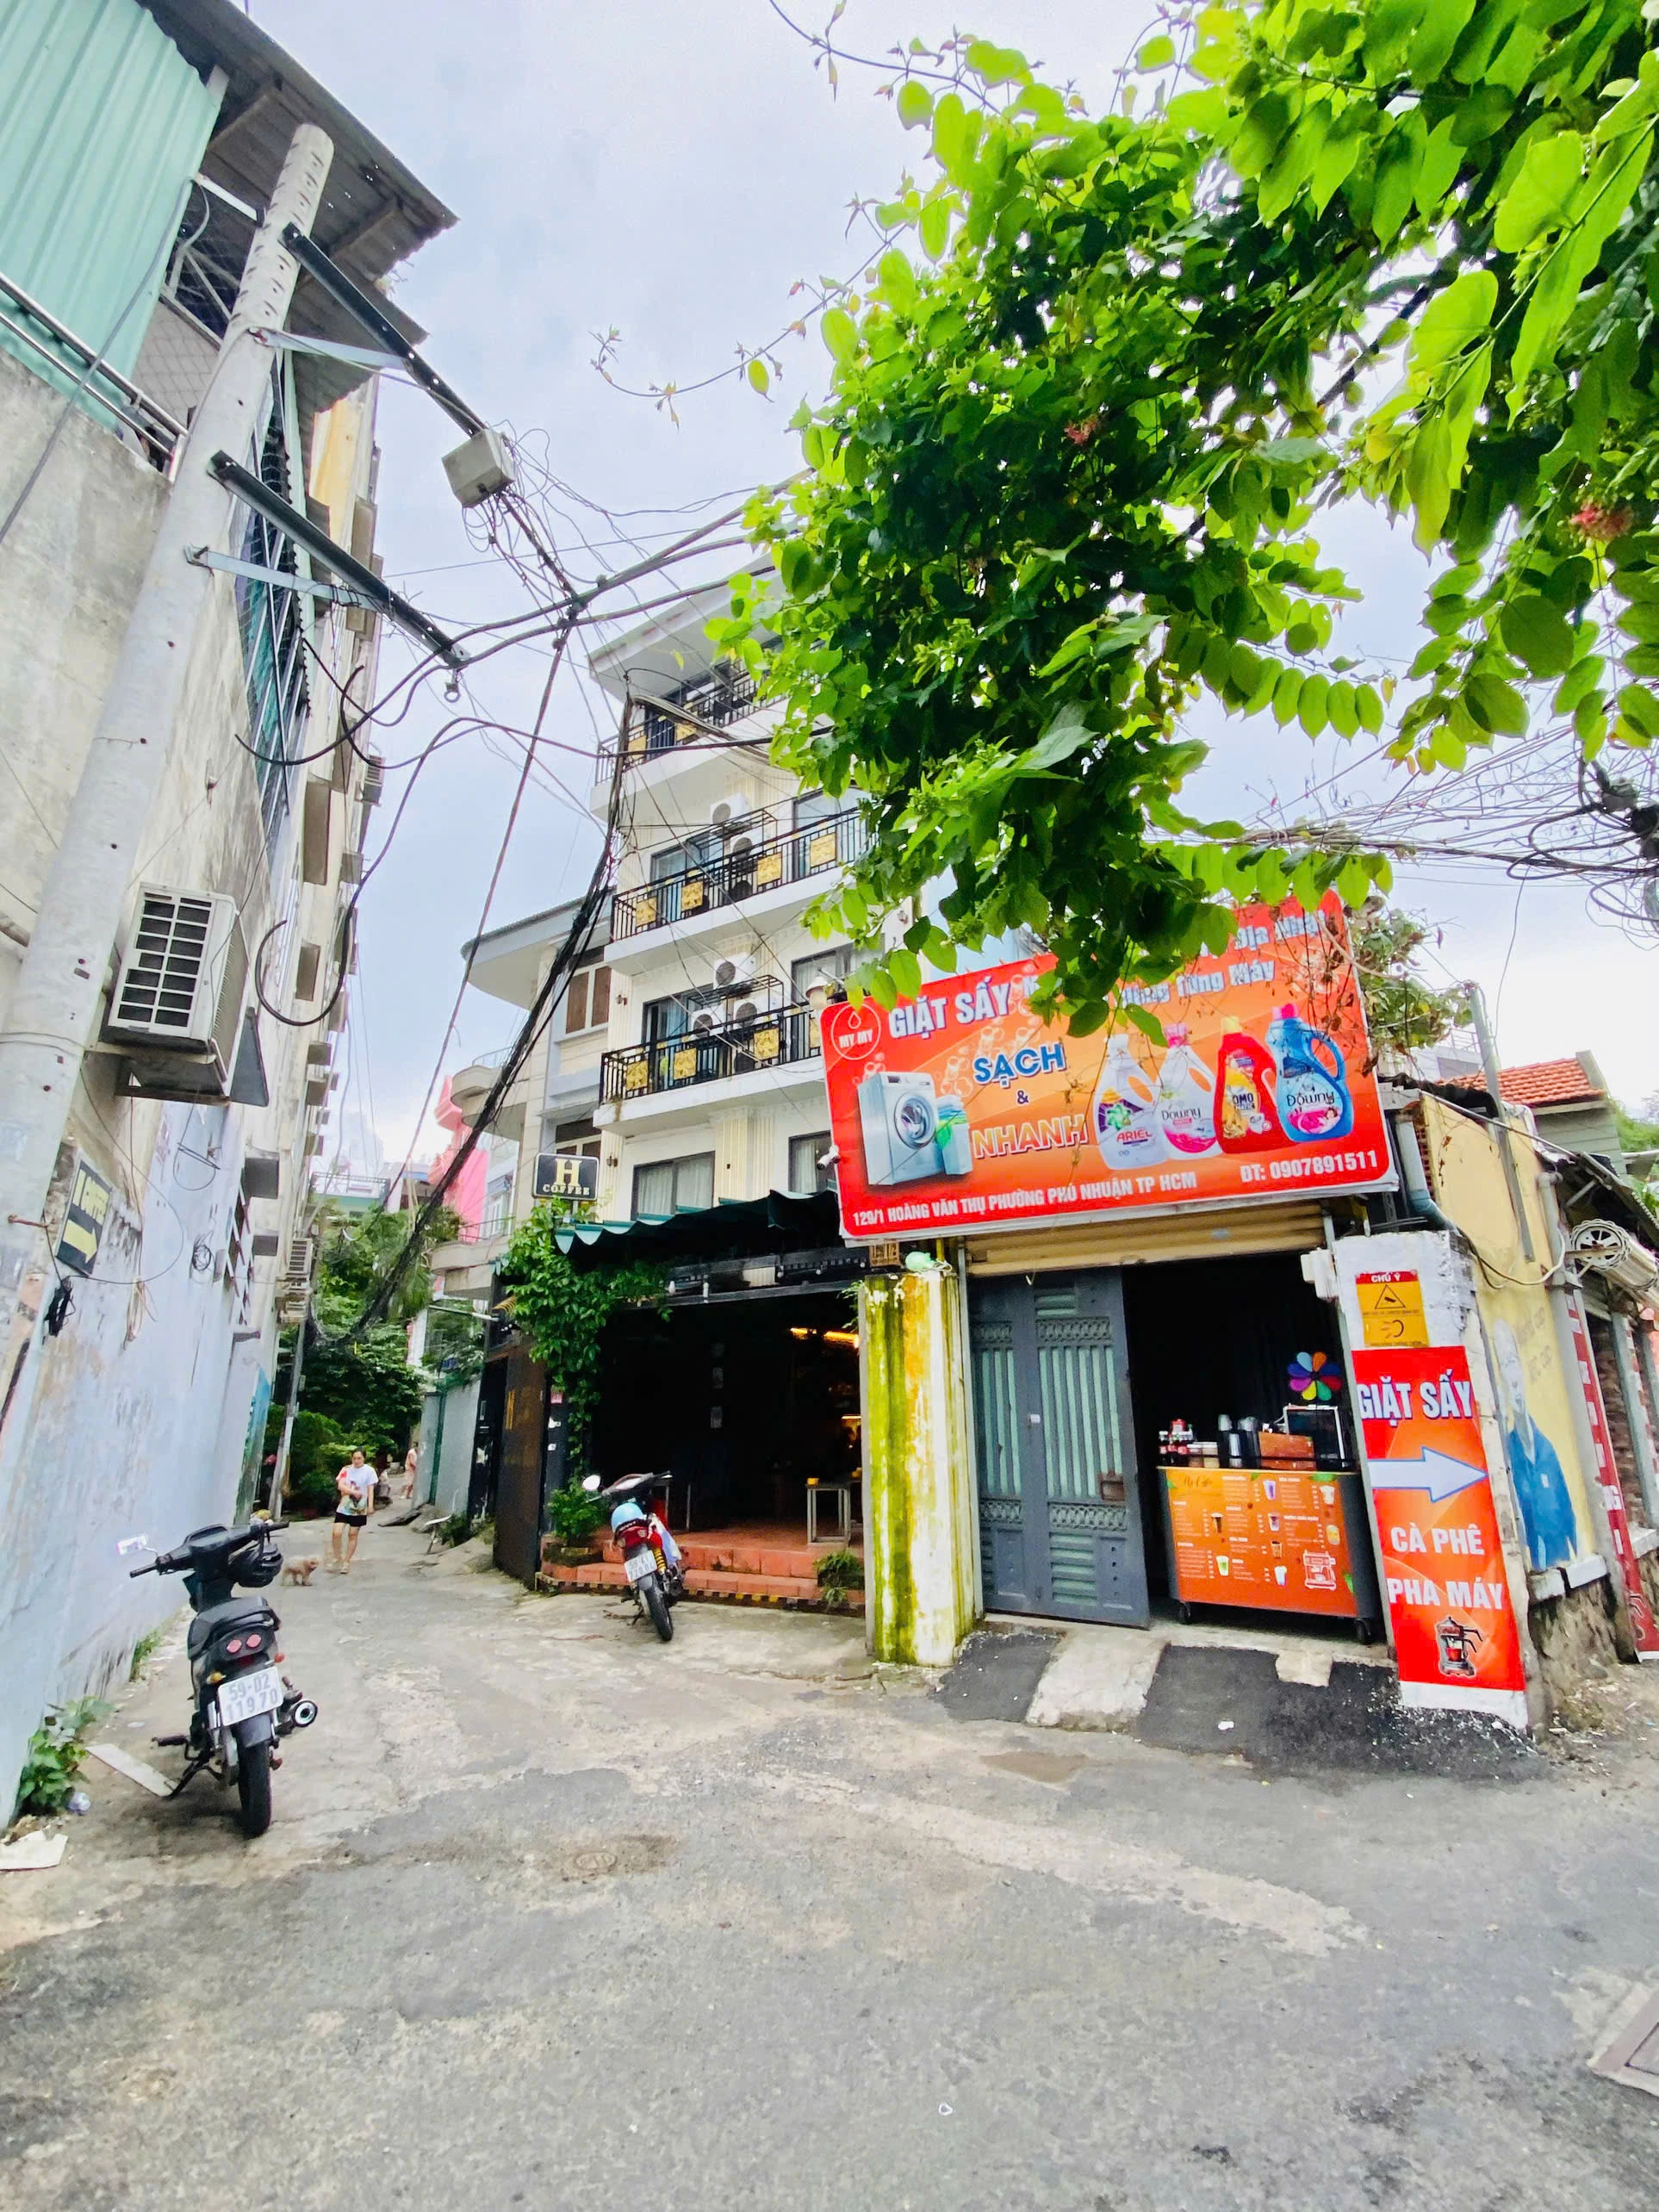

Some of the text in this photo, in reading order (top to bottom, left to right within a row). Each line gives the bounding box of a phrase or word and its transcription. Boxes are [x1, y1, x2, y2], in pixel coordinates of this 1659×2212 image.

[888, 995, 948, 1040] GIẶT
[954, 977, 1010, 1024] SẤY
[839, 1029, 873, 1048] MY MY
[972, 1042, 1066, 1088] SẠCH
[1016, 1090, 1029, 1104] &
[1287, 1090, 1334, 1107] Downy
[1161, 1107, 1201, 1121] Downy
[972, 1114, 1089, 1159] NHANH
[1116, 1129, 1153, 1142] ARIEL
[554, 1158, 583, 1186] H
[1270, 1150, 1378, 1179] 0907891511
[542, 1184, 591, 1196] COFFEE
[887, 1203, 930, 1222] HOÀNG
[931, 1198, 959, 1217] VĂN
[960, 1195, 985, 1216] THỤ
[988, 1188, 1045, 1211] PHƯỜNG
[1047, 1184, 1077, 1204] PHÚ
[1080, 1177, 1132, 1201] NHUẬN
[1135, 1177, 1155, 1194] TP
[1159, 1171, 1198, 1192] HCM
[1357, 1368, 1472, 1428] GIẶT SẤY
[1391, 1522, 1485, 1555] CÀ PHÊ
[1387, 1576, 1503, 1610] PHA MÁY
